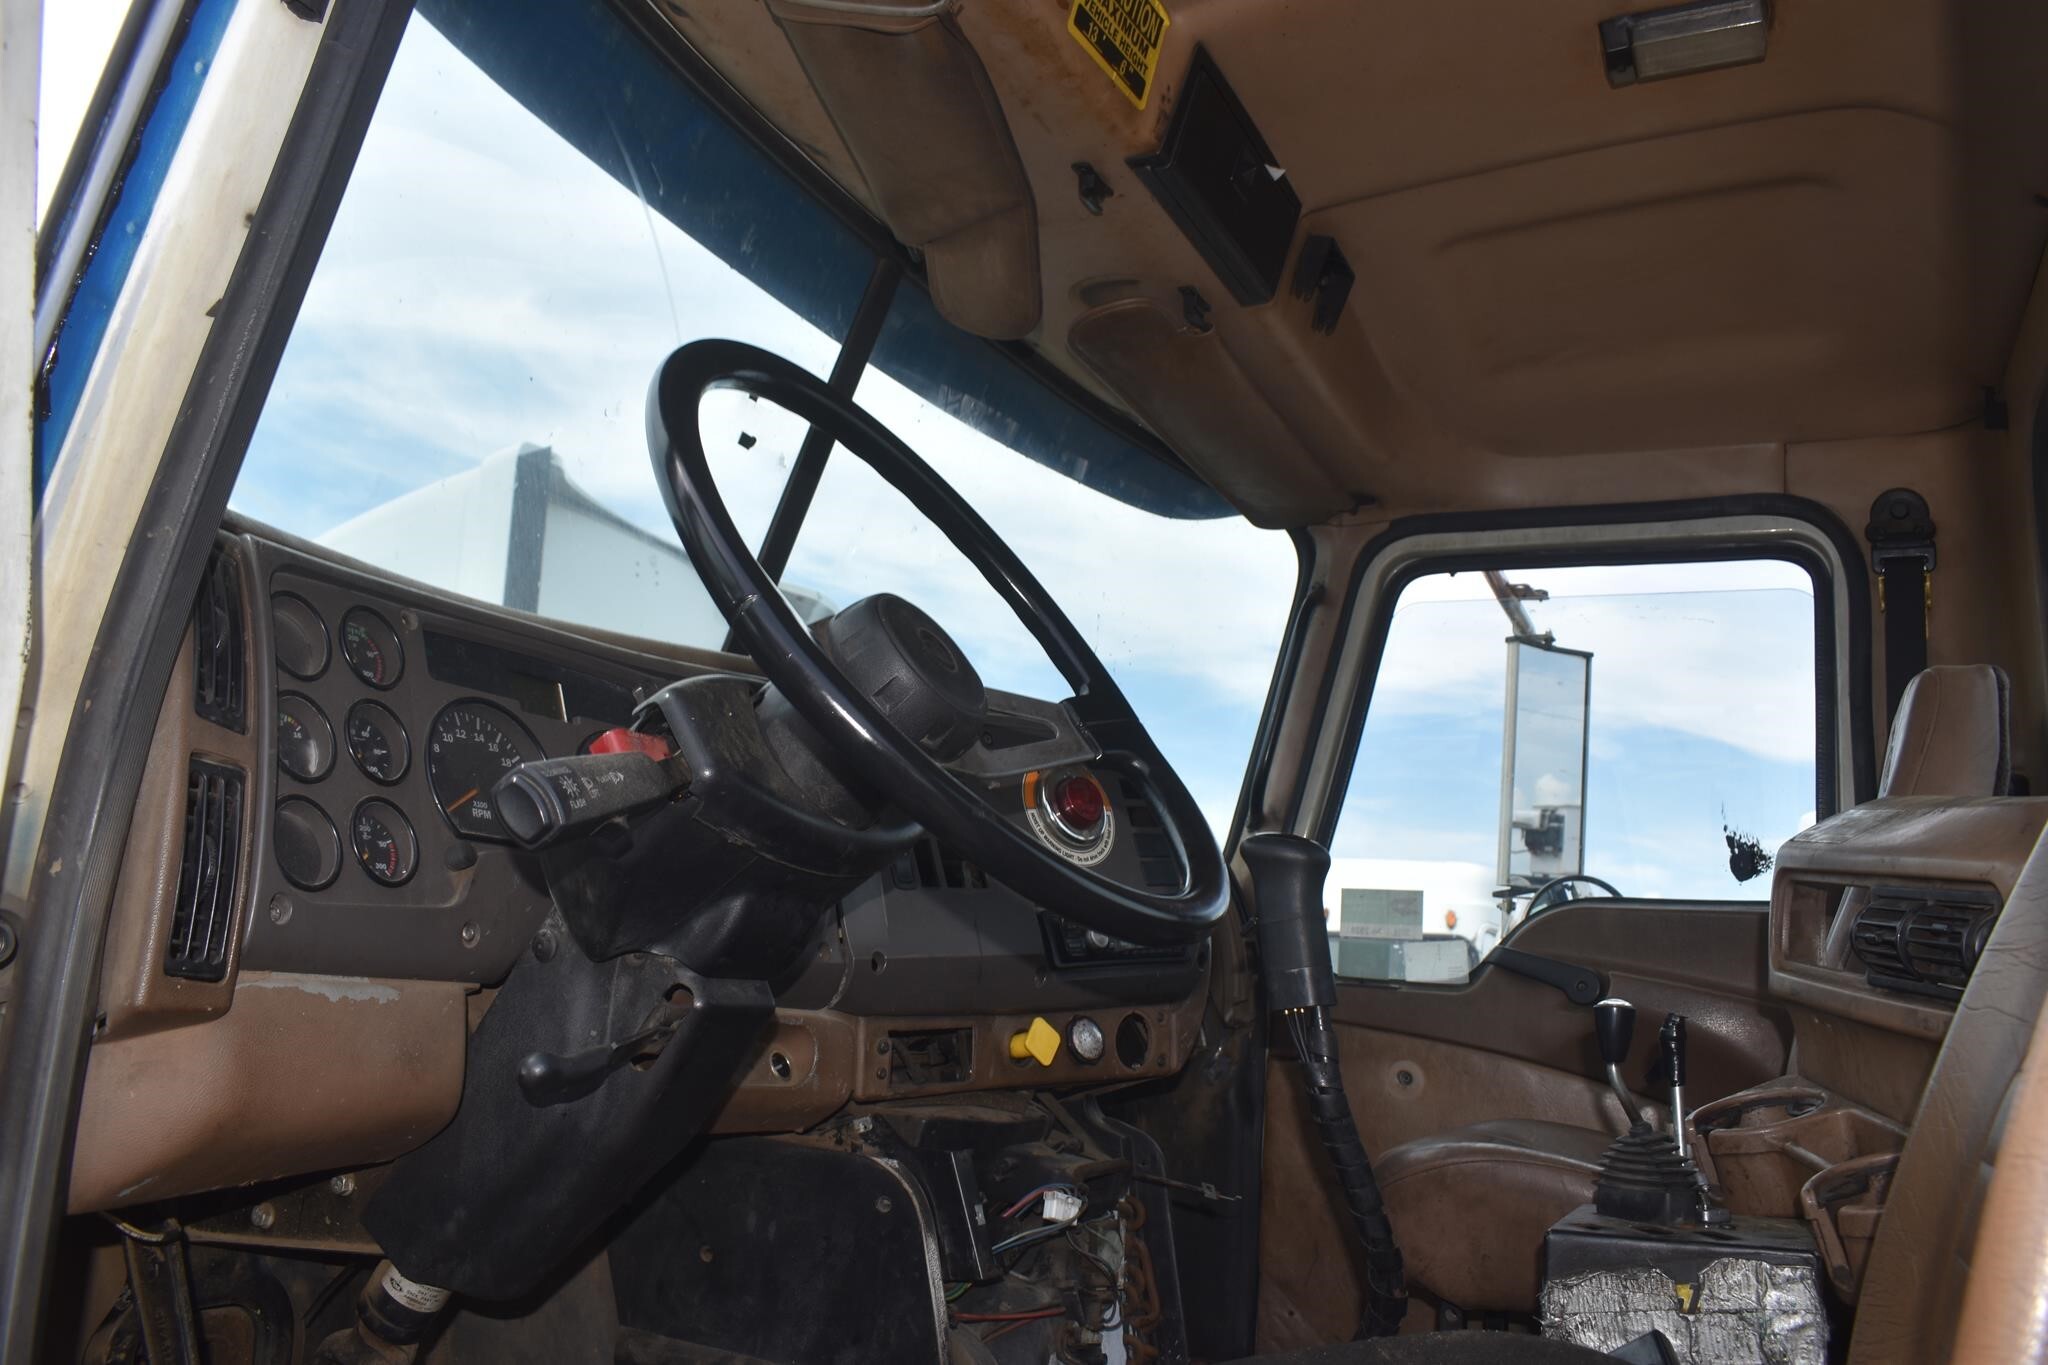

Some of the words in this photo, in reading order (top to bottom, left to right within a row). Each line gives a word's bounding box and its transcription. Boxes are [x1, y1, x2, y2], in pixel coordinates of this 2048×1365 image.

[1098, 0, 1149, 59] AXIMUM
[1119, 0, 1160, 44] TION
[1119, 36, 1148, 77] HEIGHT
[442, 732, 454, 743] 10
[455, 728, 467, 739] 12
[474, 732, 485, 743] 14
[433, 743, 441, 753] 8
[488, 743, 499, 753] 16
[501, 757, 512, 768] 18
[472, 808, 492, 820] RPM
[1043, 834, 1062, 854] WARNING
[1061, 850, 1075, 860] LIGHT
